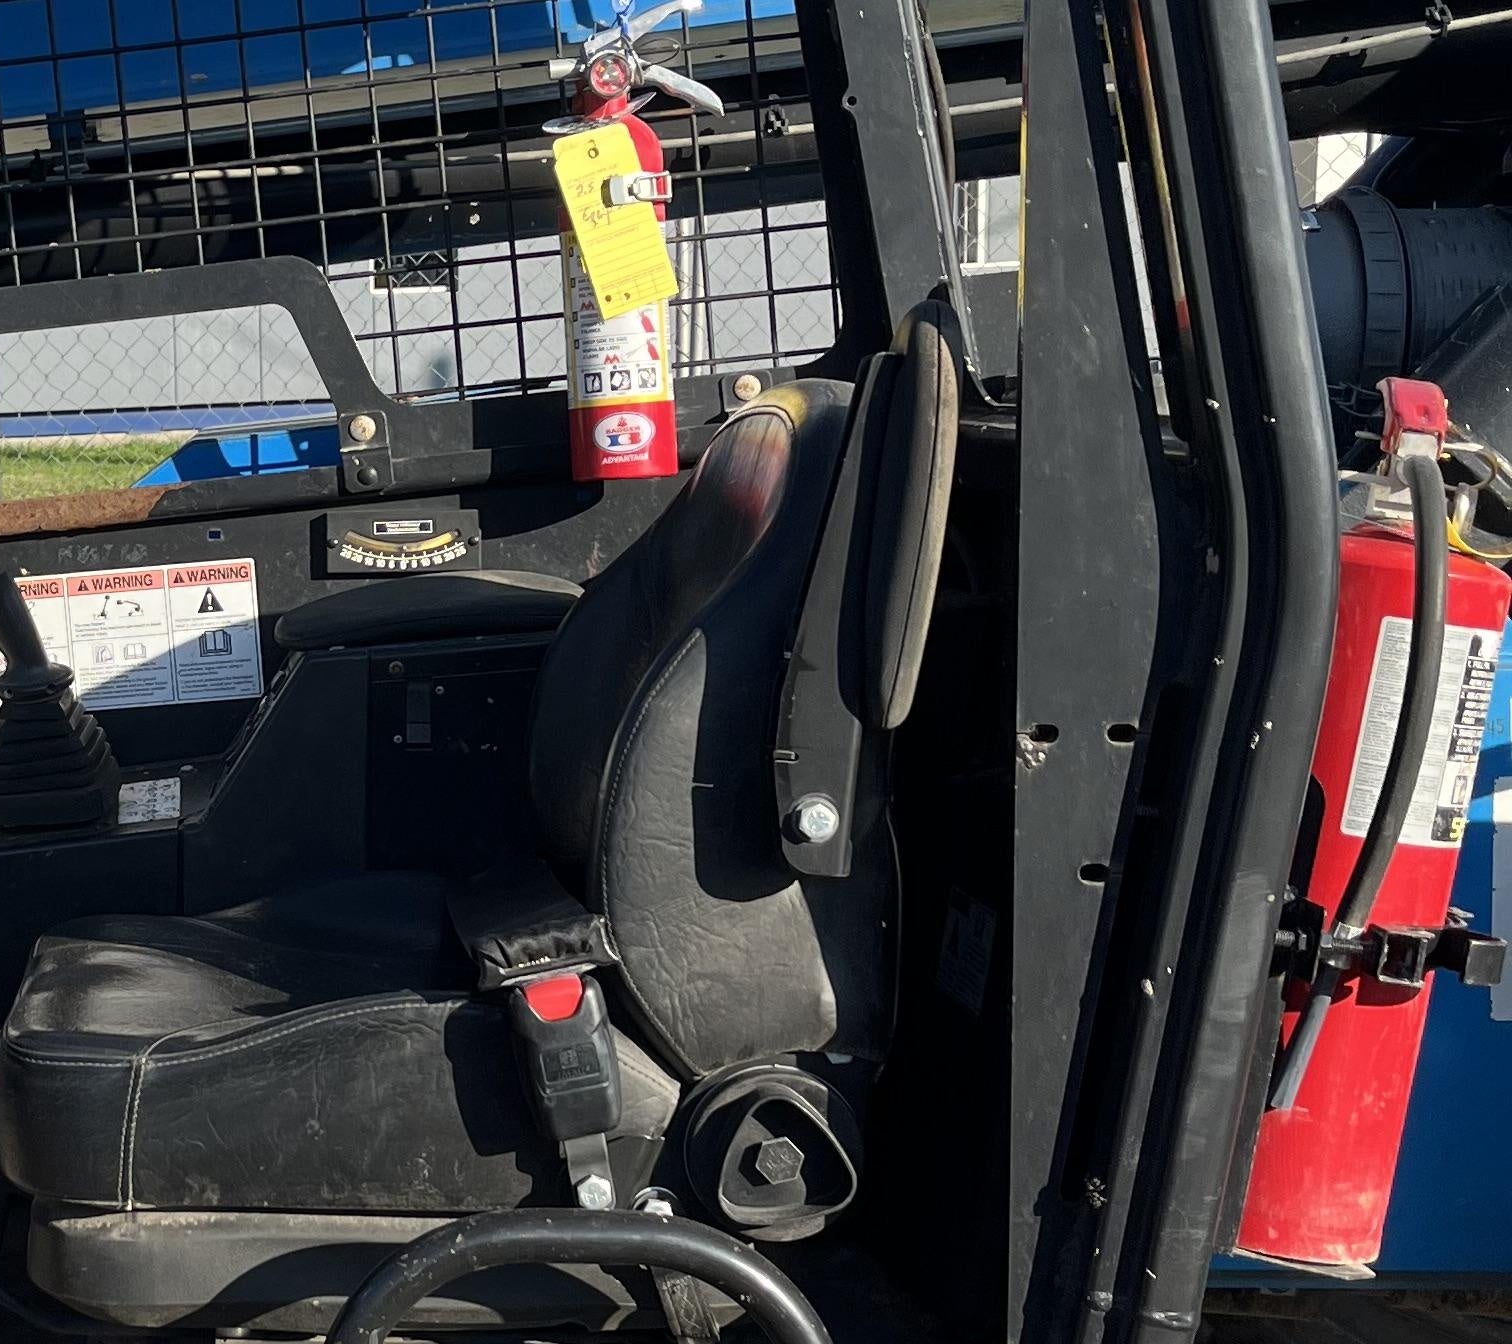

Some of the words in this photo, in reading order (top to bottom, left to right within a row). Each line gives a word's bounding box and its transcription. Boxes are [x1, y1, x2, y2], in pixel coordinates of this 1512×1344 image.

[91, 574, 153, 592] WARNING
[187, 565, 249, 583] WARNING
[19, 581, 60, 597] RNING
